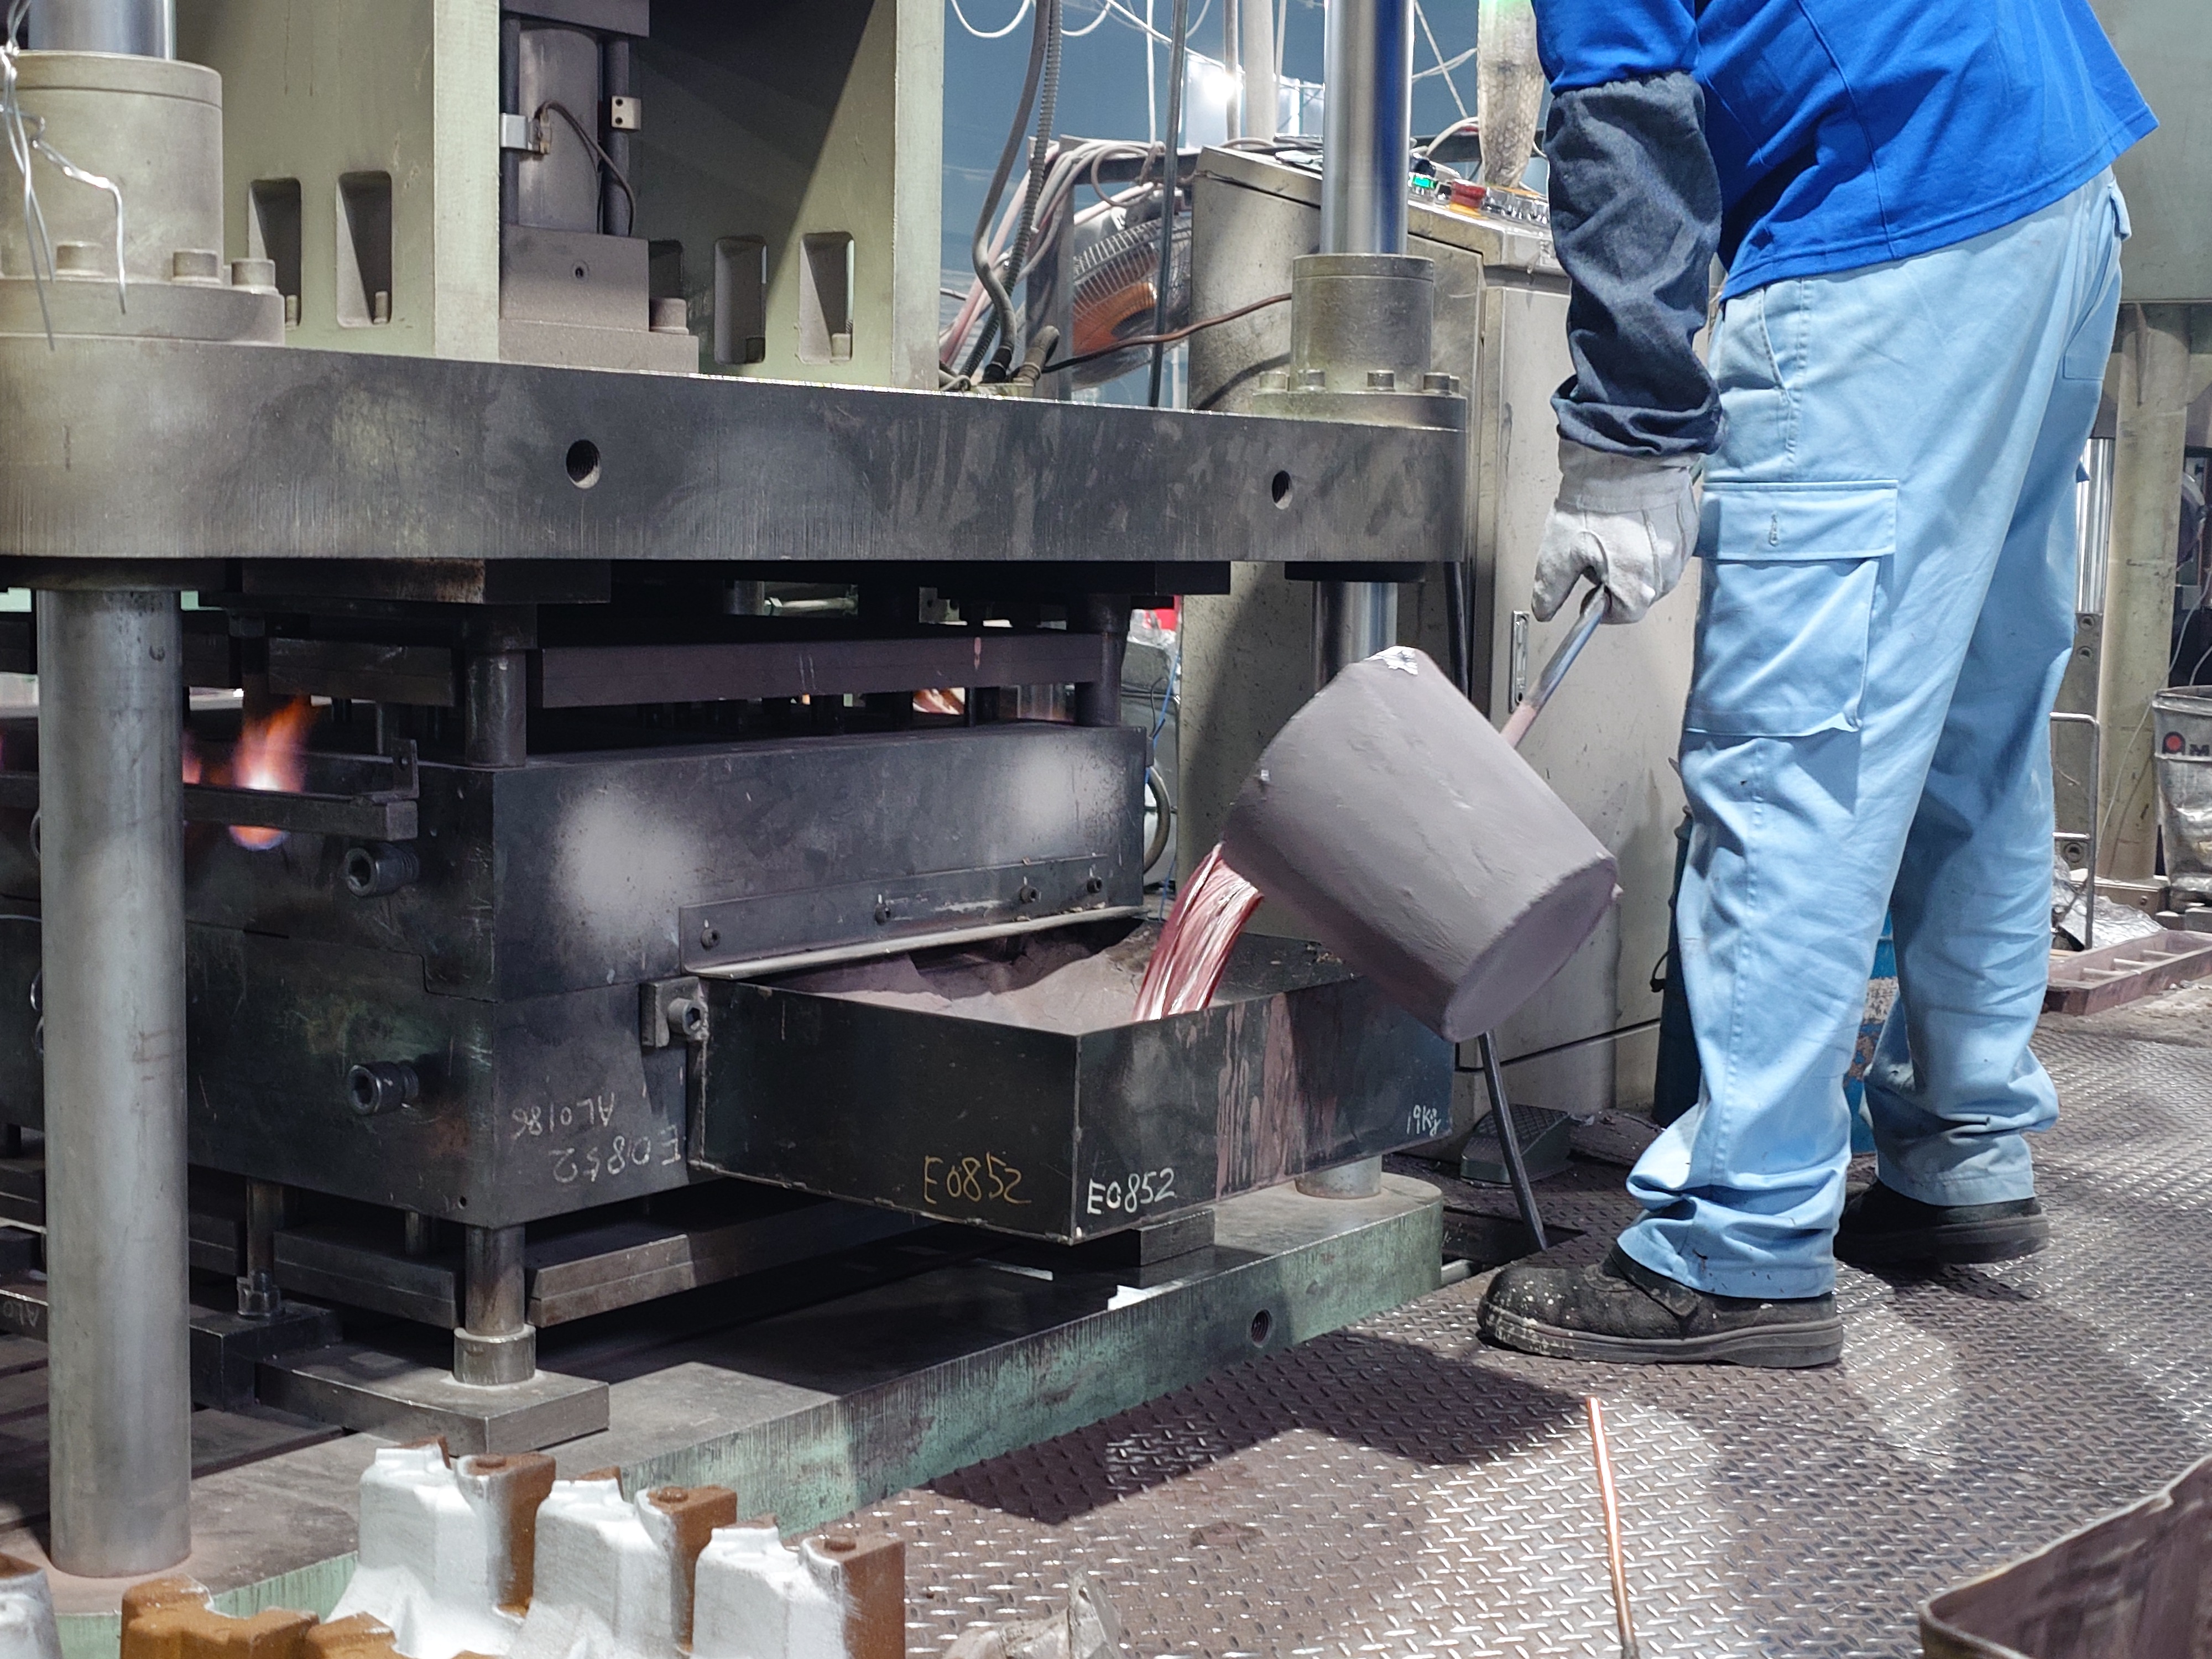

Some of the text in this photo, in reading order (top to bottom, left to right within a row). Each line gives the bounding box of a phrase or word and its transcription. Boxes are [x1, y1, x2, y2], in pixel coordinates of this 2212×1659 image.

[549, 1124, 681, 1182] E0852
[924, 1152, 1032, 1204] E0852
[1087, 1167, 1175, 1215] E0852
